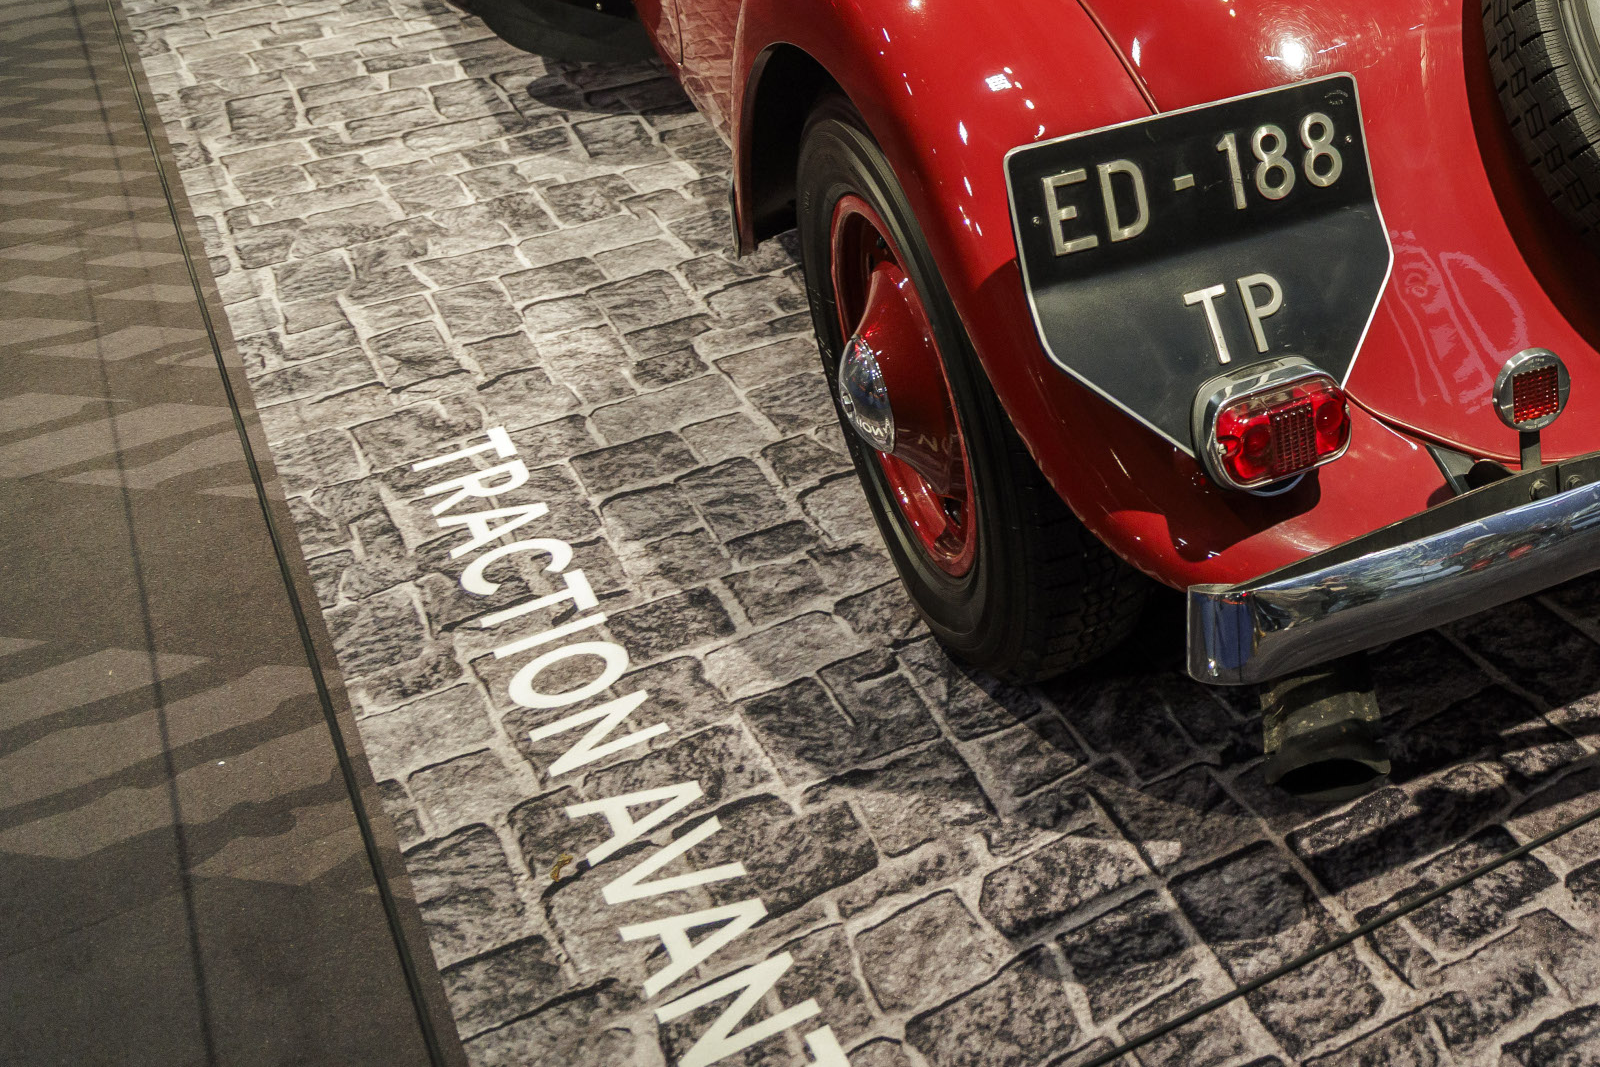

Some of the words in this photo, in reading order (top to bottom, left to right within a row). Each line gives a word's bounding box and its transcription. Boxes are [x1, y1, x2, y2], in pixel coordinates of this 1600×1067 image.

[1041, 158, 1150, 256] ED
[1215, 111, 1343, 210] 188
[1182, 272, 1284, 366] TP
[412, 425, 670, 778] TRACTION
